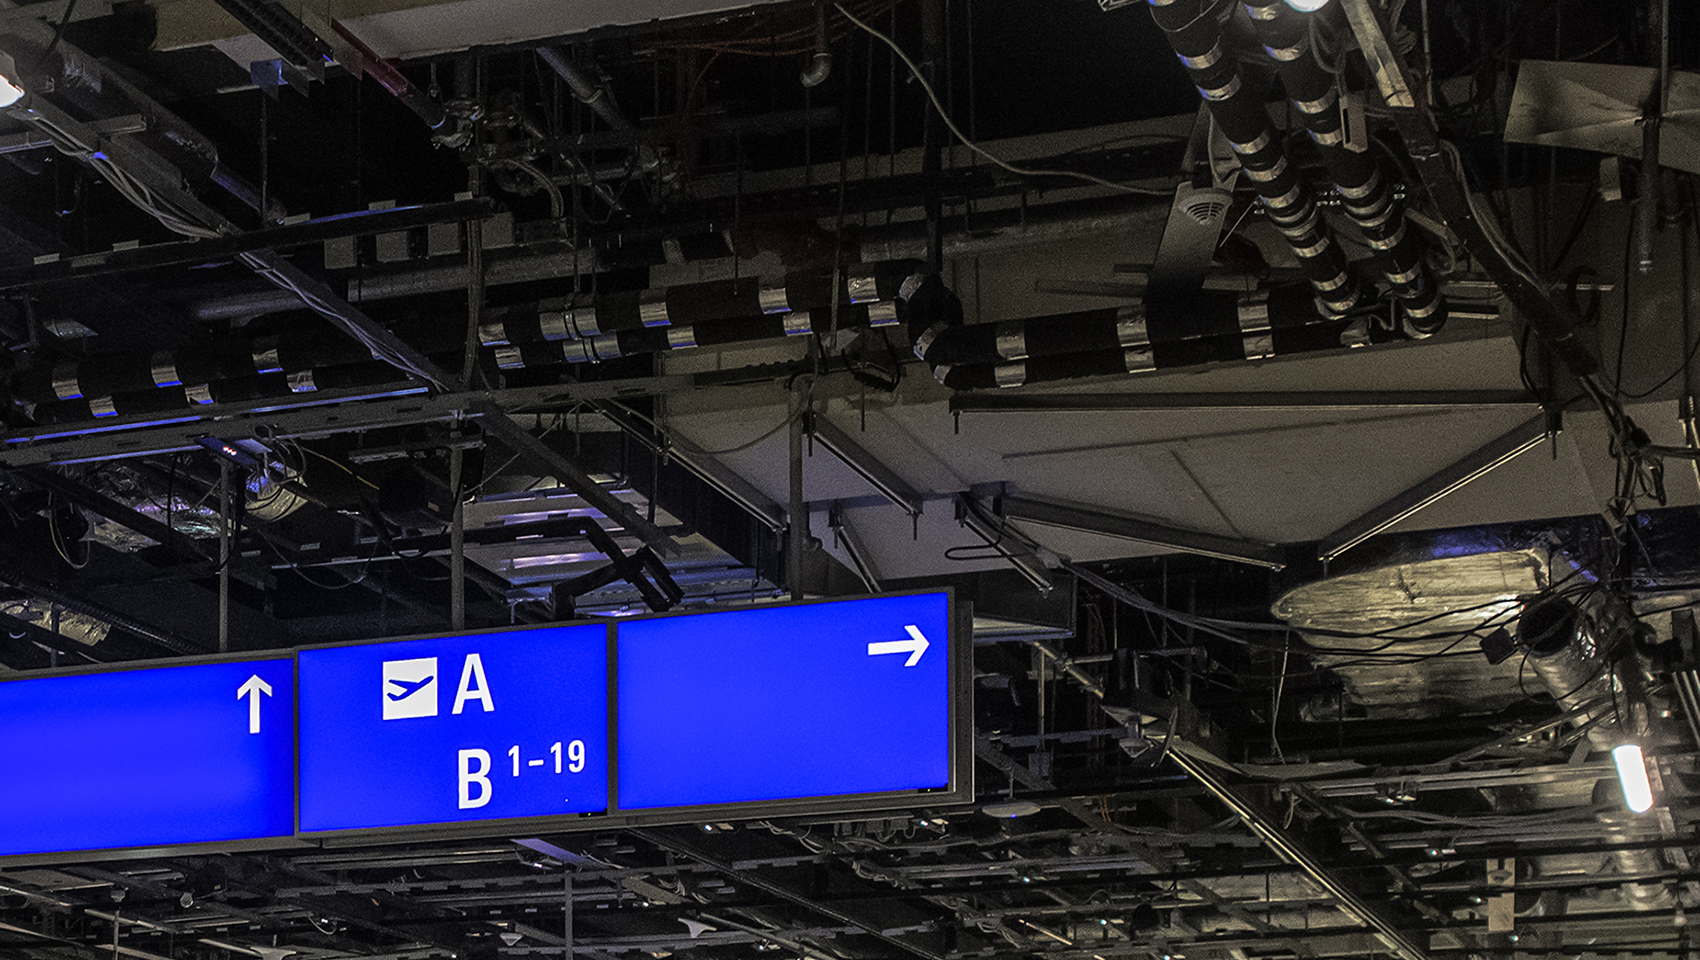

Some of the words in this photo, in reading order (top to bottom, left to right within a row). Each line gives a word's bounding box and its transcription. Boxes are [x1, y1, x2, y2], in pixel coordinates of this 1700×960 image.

[452, 653, 494, 715] A
[458, 748, 493, 809] B
[508, 740, 585, 777] 1-19
